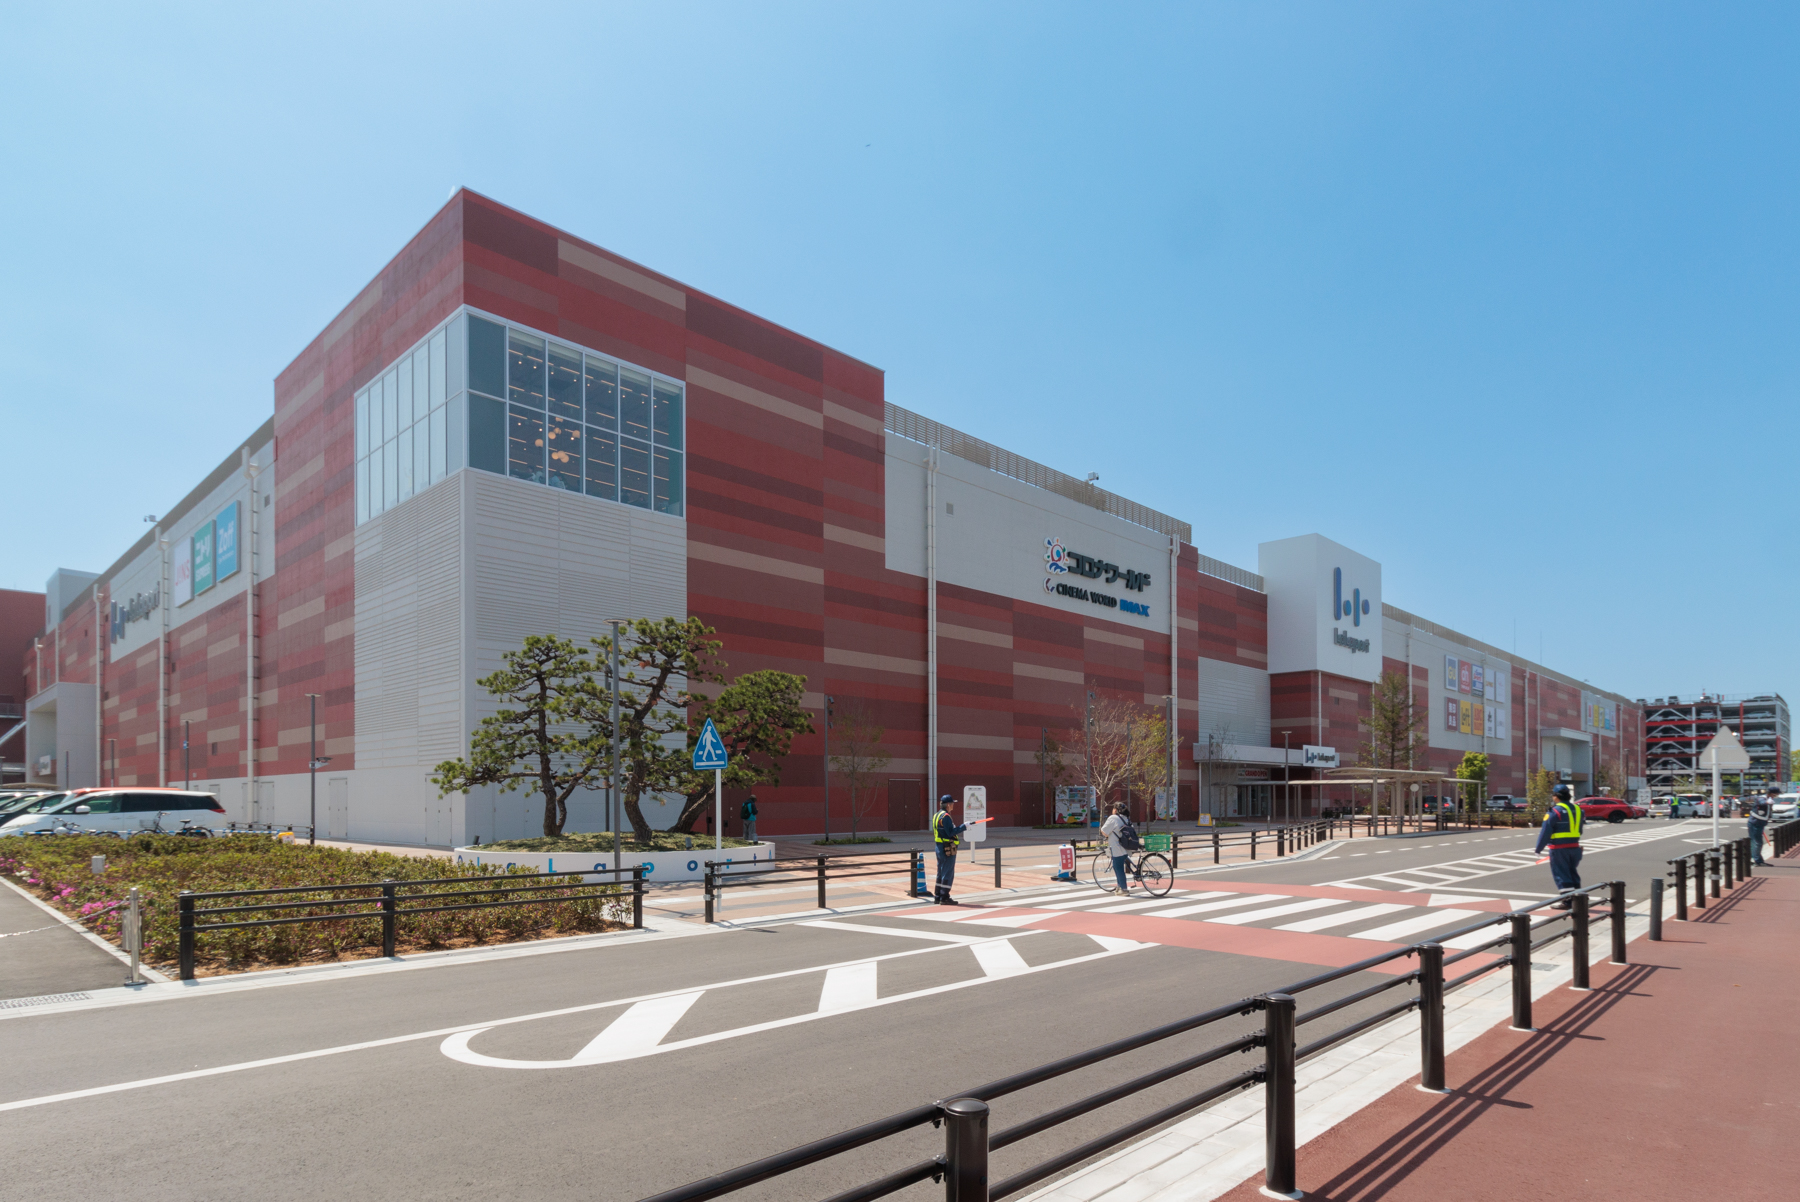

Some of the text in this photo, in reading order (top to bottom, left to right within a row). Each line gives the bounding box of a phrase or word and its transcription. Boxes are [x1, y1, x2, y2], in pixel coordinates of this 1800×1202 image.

[195, 534, 211, 564] ニトリ
[1067, 551, 1151, 592] コロナワールド
[1056, 583, 1150, 617] CINEMA WORLD IMAX
[1448, 666, 1457, 680] GU
